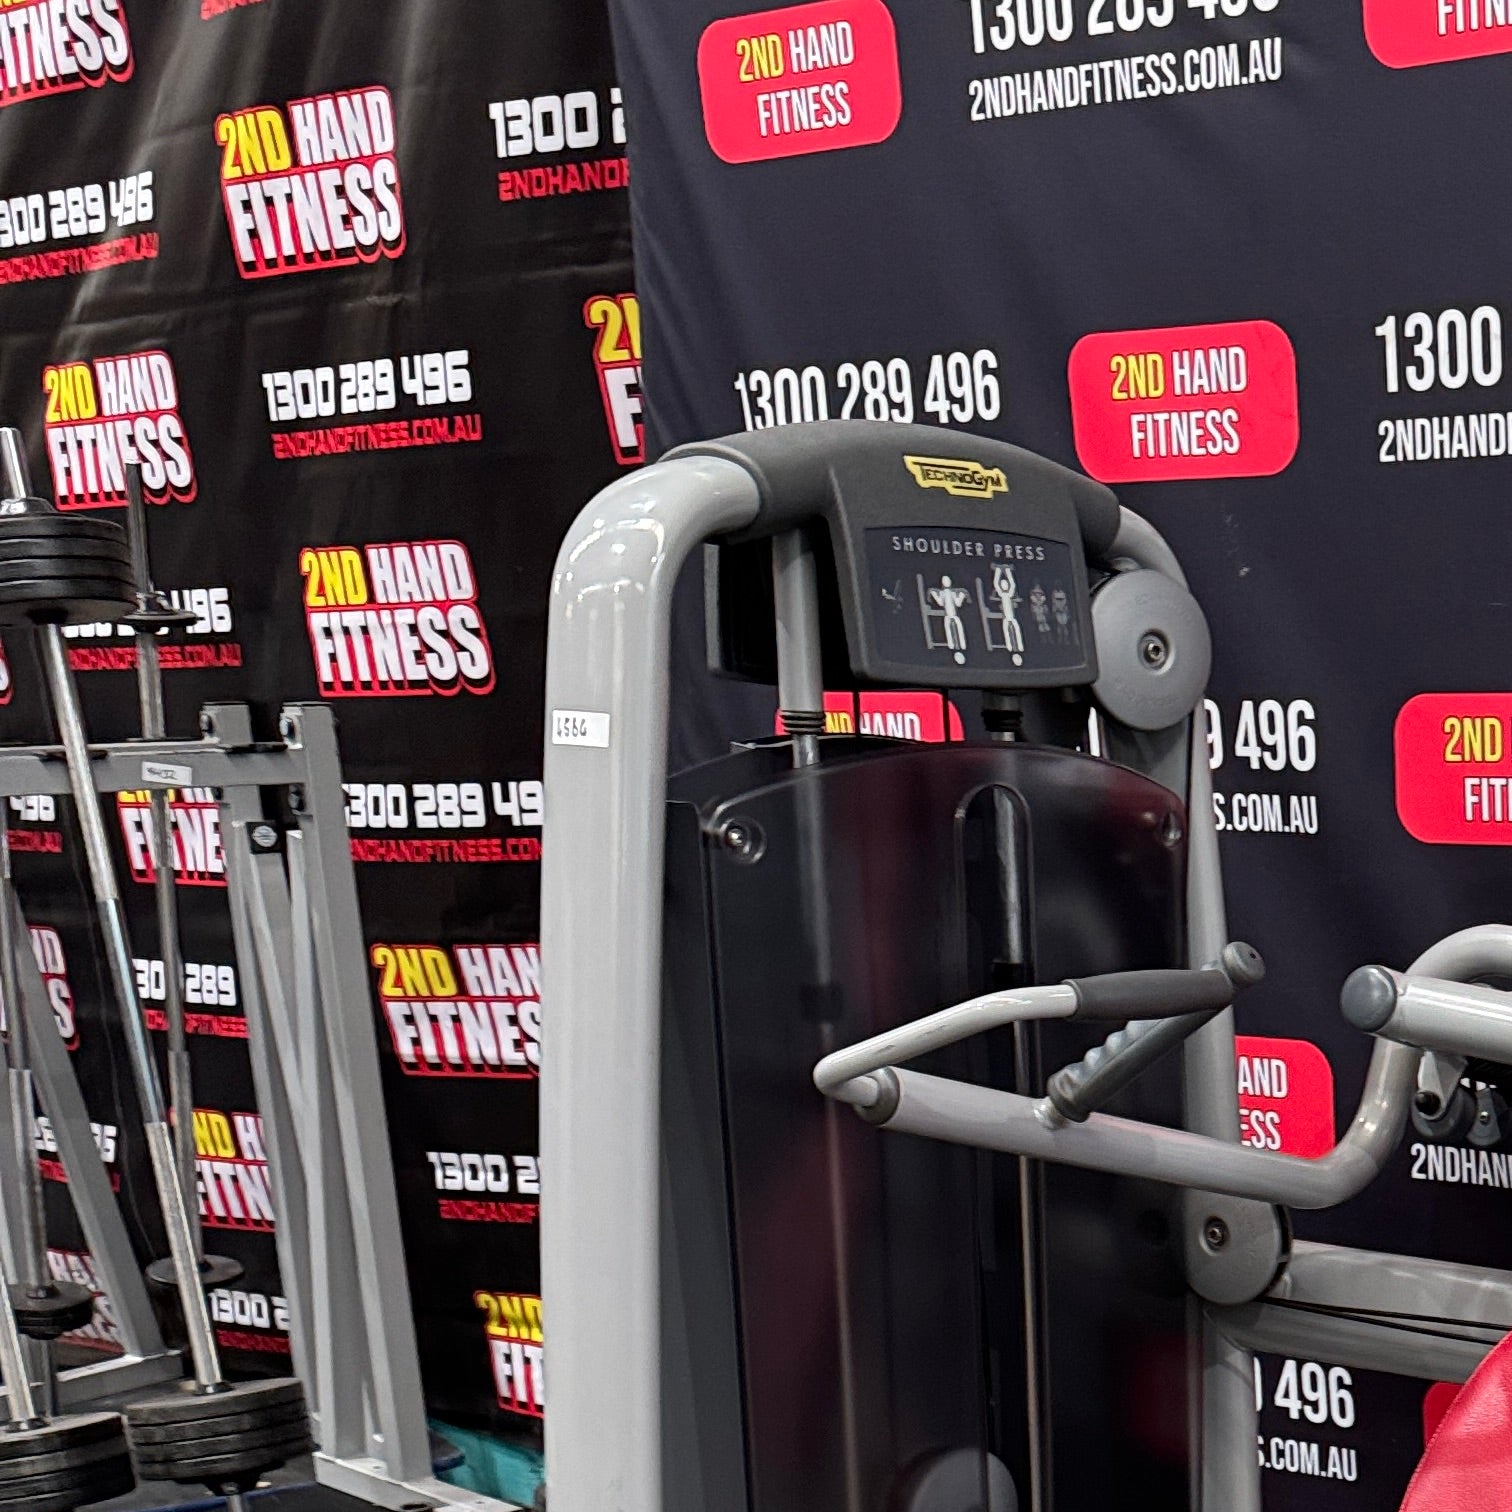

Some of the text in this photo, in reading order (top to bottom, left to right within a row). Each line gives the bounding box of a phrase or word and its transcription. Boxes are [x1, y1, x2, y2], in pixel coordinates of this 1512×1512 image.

[737, 22, 853, 81] 2ND HAND
[969, 37, 1281, 121] 2NDHANDFITNESS.COM.AU
[218, 91, 394, 179] 2ND HAND
[489, 91, 598, 158] 1300
[758, 82, 850, 135] FITNESS
[48, 184, 106, 239] 289
[109, 171, 153, 227] 496
[226, 159, 401, 262] FITNESS
[1111, 347, 1246, 399] 2ND HAND
[1376, 306, 1502, 392] 1300
[45, 355, 176, 422] 2ND HAND
[262, 350, 471, 421] 1300 289 496
[734, 349, 1000, 432] 1300 289 496
[47, 414, 192, 497] FITNESS
[1132, 409, 1238, 456] FITNESS
[302, 544, 473, 606] 2ND HAND
[892, 537, 1046, 561] SHOULDER PRESS
[311, 605, 489, 682] FITNESS
[826, 712, 854, 734] ND
[1235, 700, 1315, 771] 496
[1445, 718, 1501, 761] 2ND
[342, 781, 543, 828] 300 289 49
[1214, 793, 1317, 835] S.COM.AU
[185, 963, 236, 1006] 289
[374, 947, 540, 996] 2ND HAN
[388, 1001, 540, 1066] FITNES
[1238, 1055, 1287, 1098] AND
[193, 1112, 235, 1158] ND
[1239, 1108, 1281, 1150] ESS
[428, 1152, 508, 1192] 1300
[210, 1289, 269, 1328] 1300
[489, 1339, 544, 1405] FIT
[1275, 1360, 1354, 1427] 496
[1257, 1436, 1357, 1482] S.COM.AU
